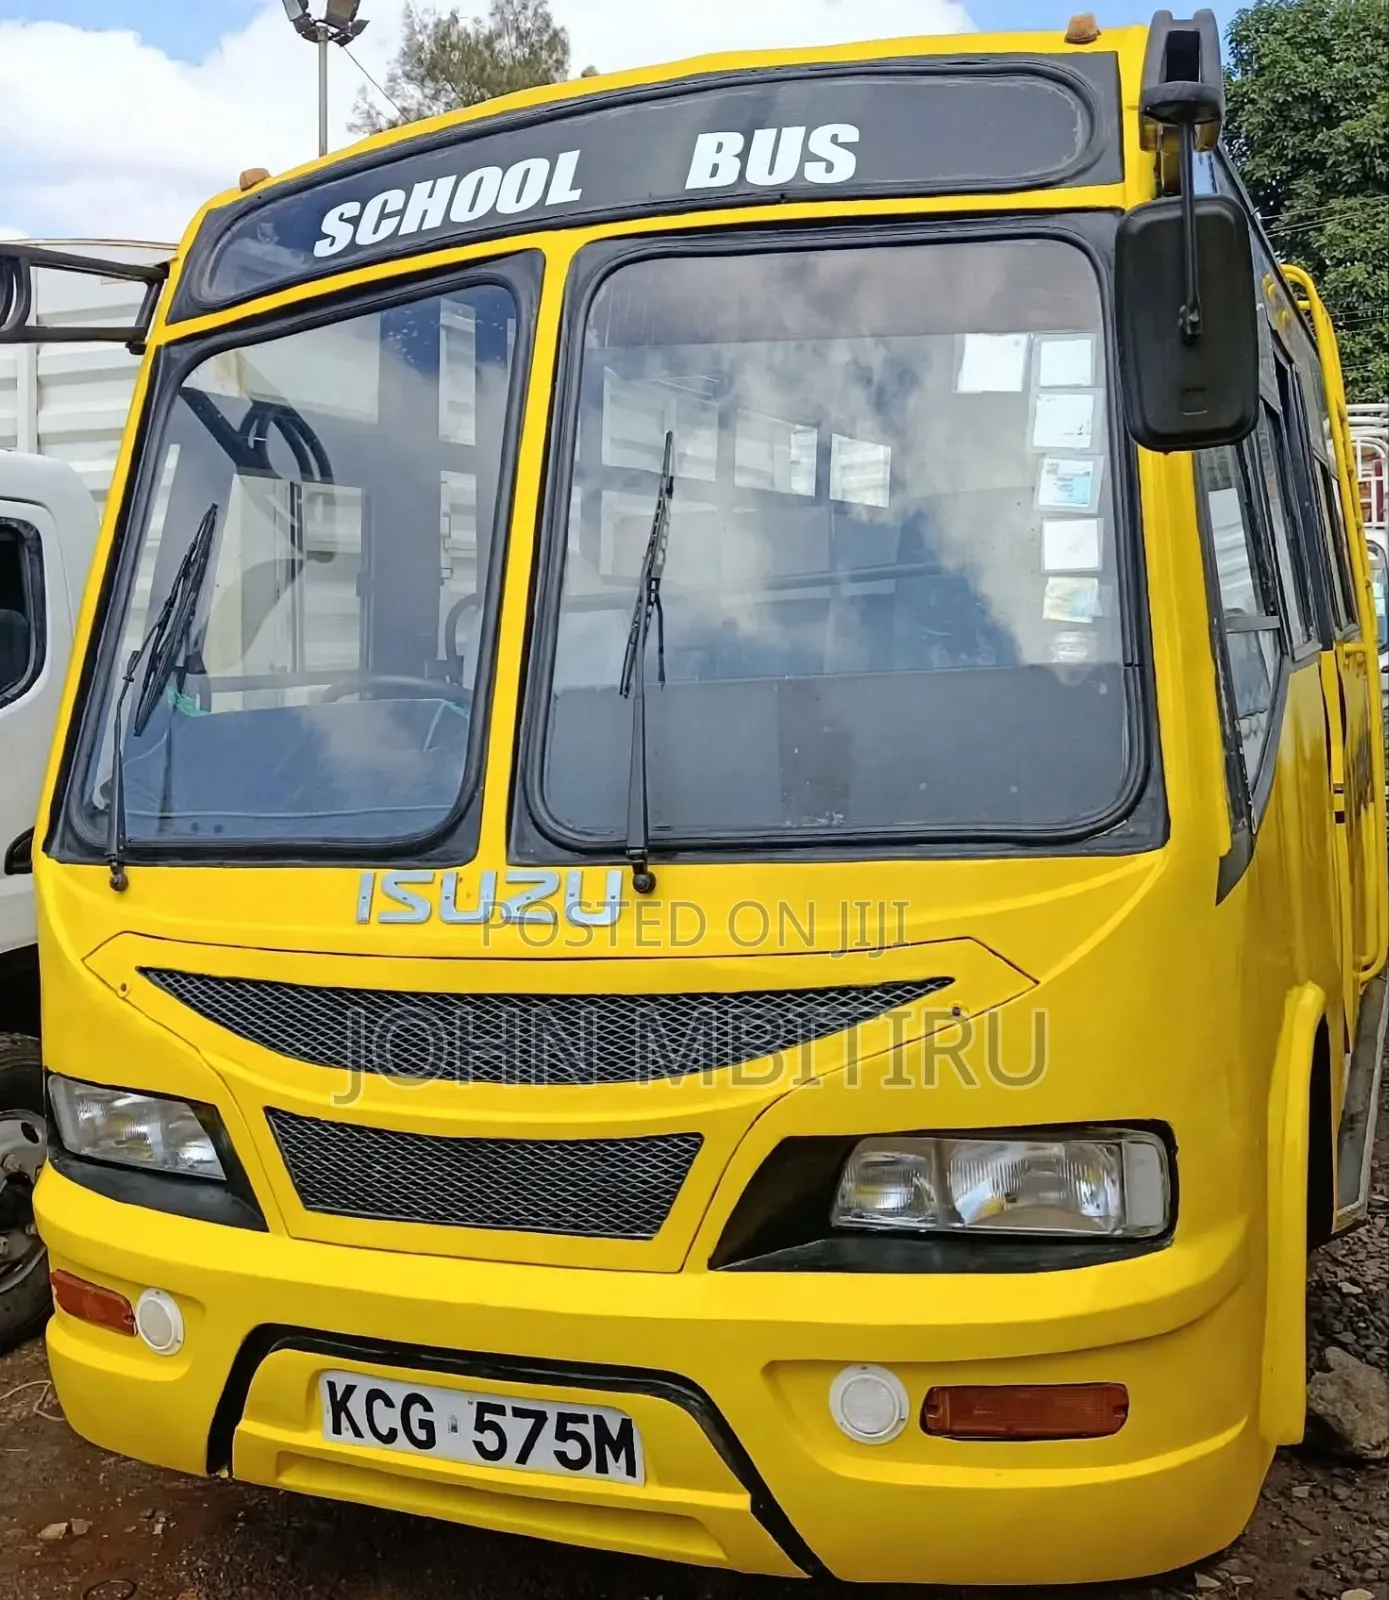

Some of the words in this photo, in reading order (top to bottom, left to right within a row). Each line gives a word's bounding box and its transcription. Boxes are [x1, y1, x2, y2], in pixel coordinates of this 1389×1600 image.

[313, 149, 582, 258] SCHOOL
[685, 123, 860, 189] BUS
[356, 870, 623, 926] ISUZU
[327, 1379, 437, 1451] KCG
[471, 1400, 638, 1479] 575M
